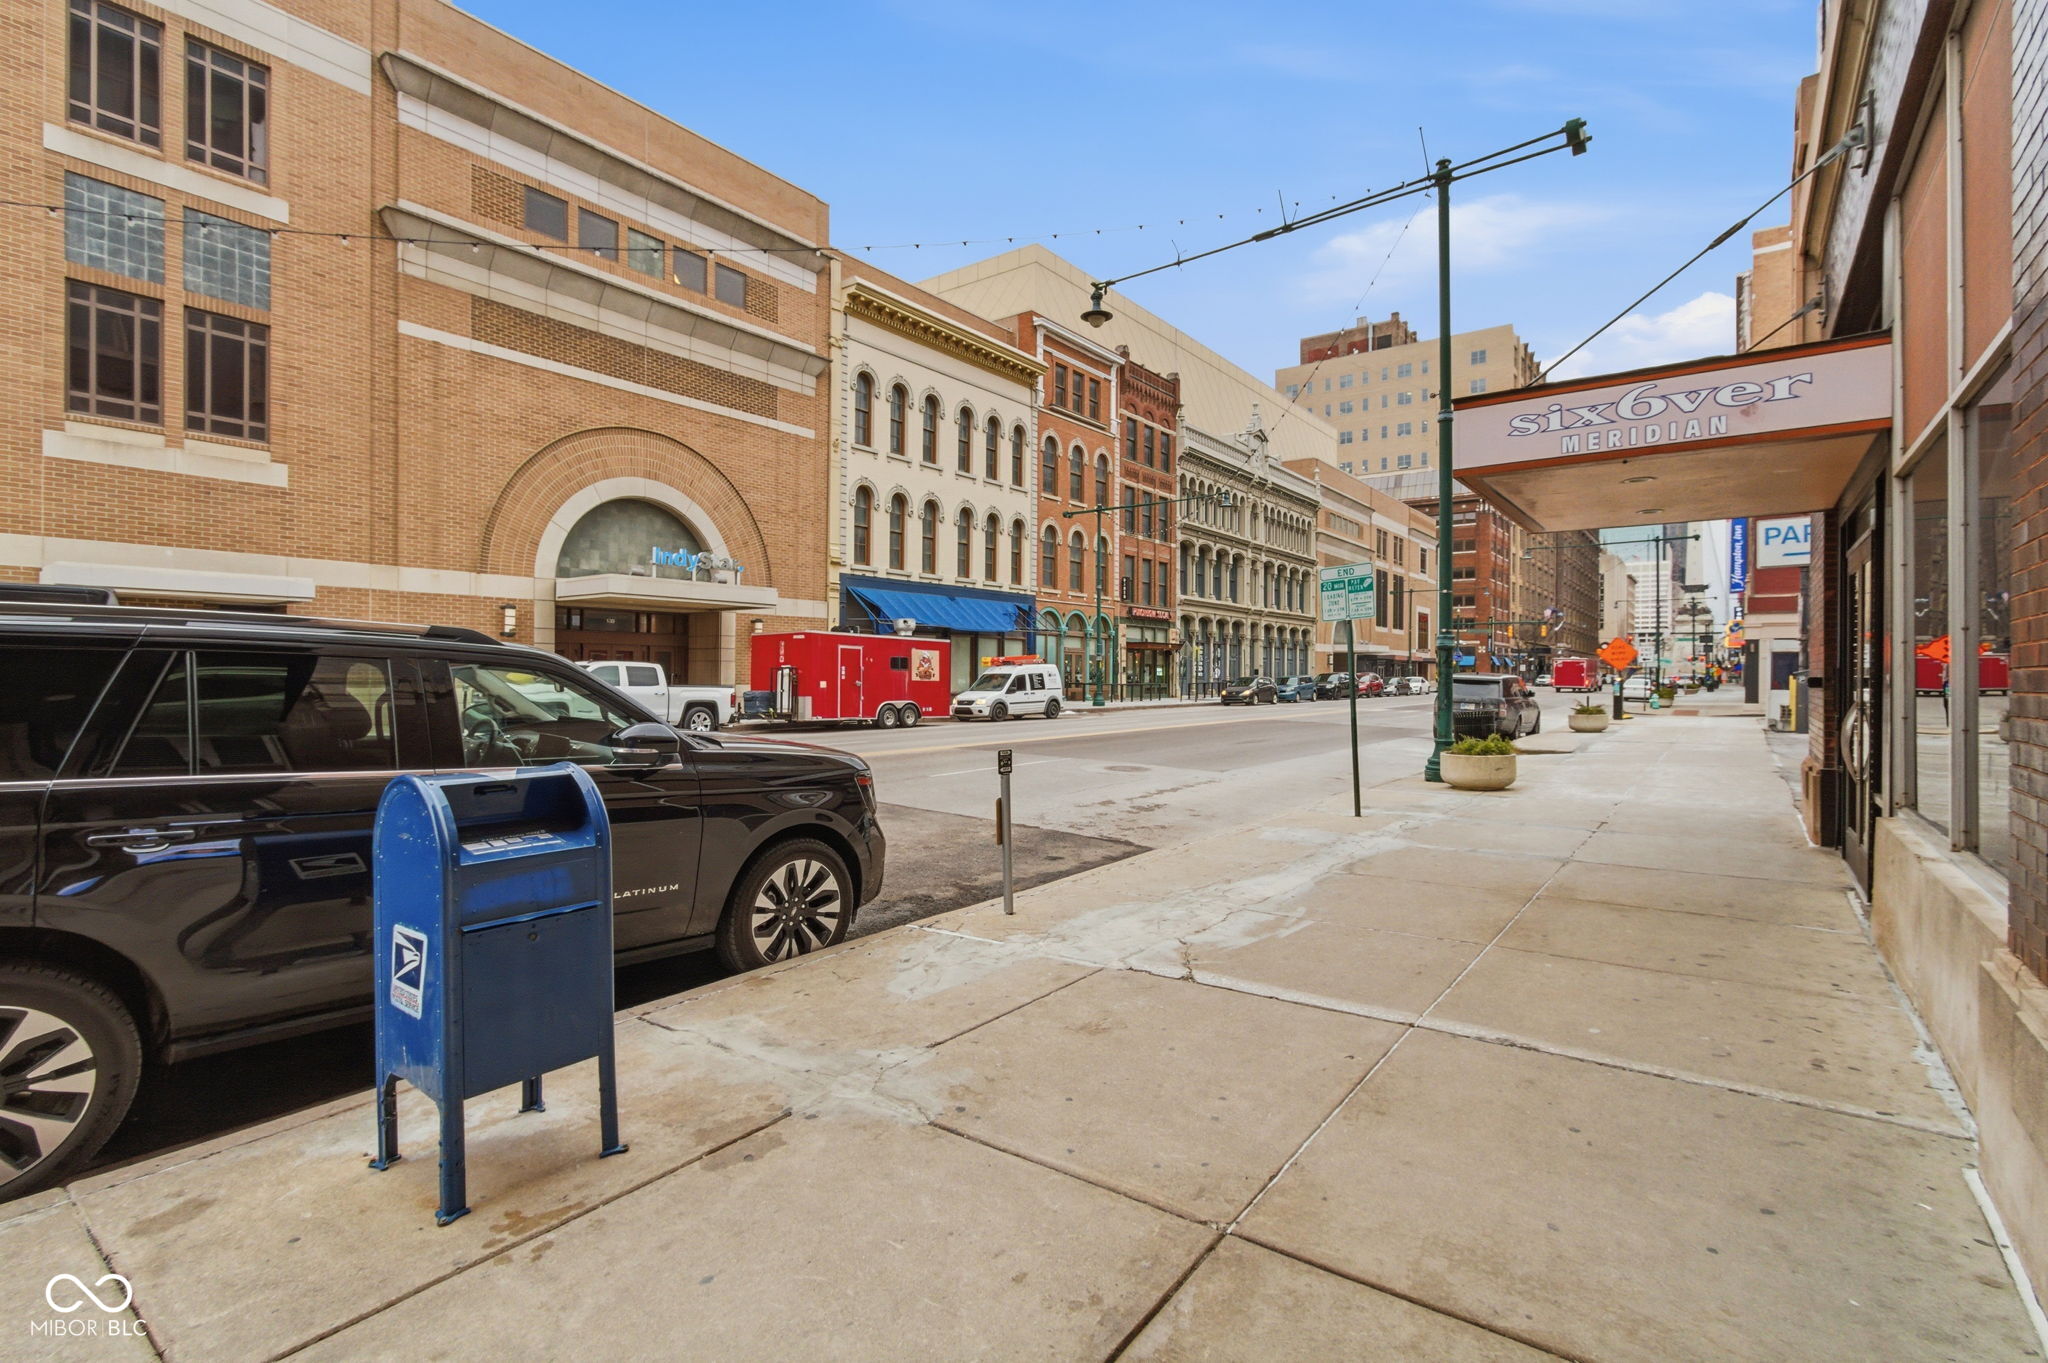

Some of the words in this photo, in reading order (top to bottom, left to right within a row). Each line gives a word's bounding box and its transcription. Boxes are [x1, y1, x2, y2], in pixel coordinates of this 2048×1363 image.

[1507, 372, 1813, 437] six6ver
[1561, 415, 1728, 455] MERIDIAN
[1733, 524, 1743, 540] Inn
[1731, 540, 1745, 588] Hampton
[1337, 568, 1355, 578] END
[1322, 582, 1333, 591] 20
[613, 884, 679, 899] LATINUM
